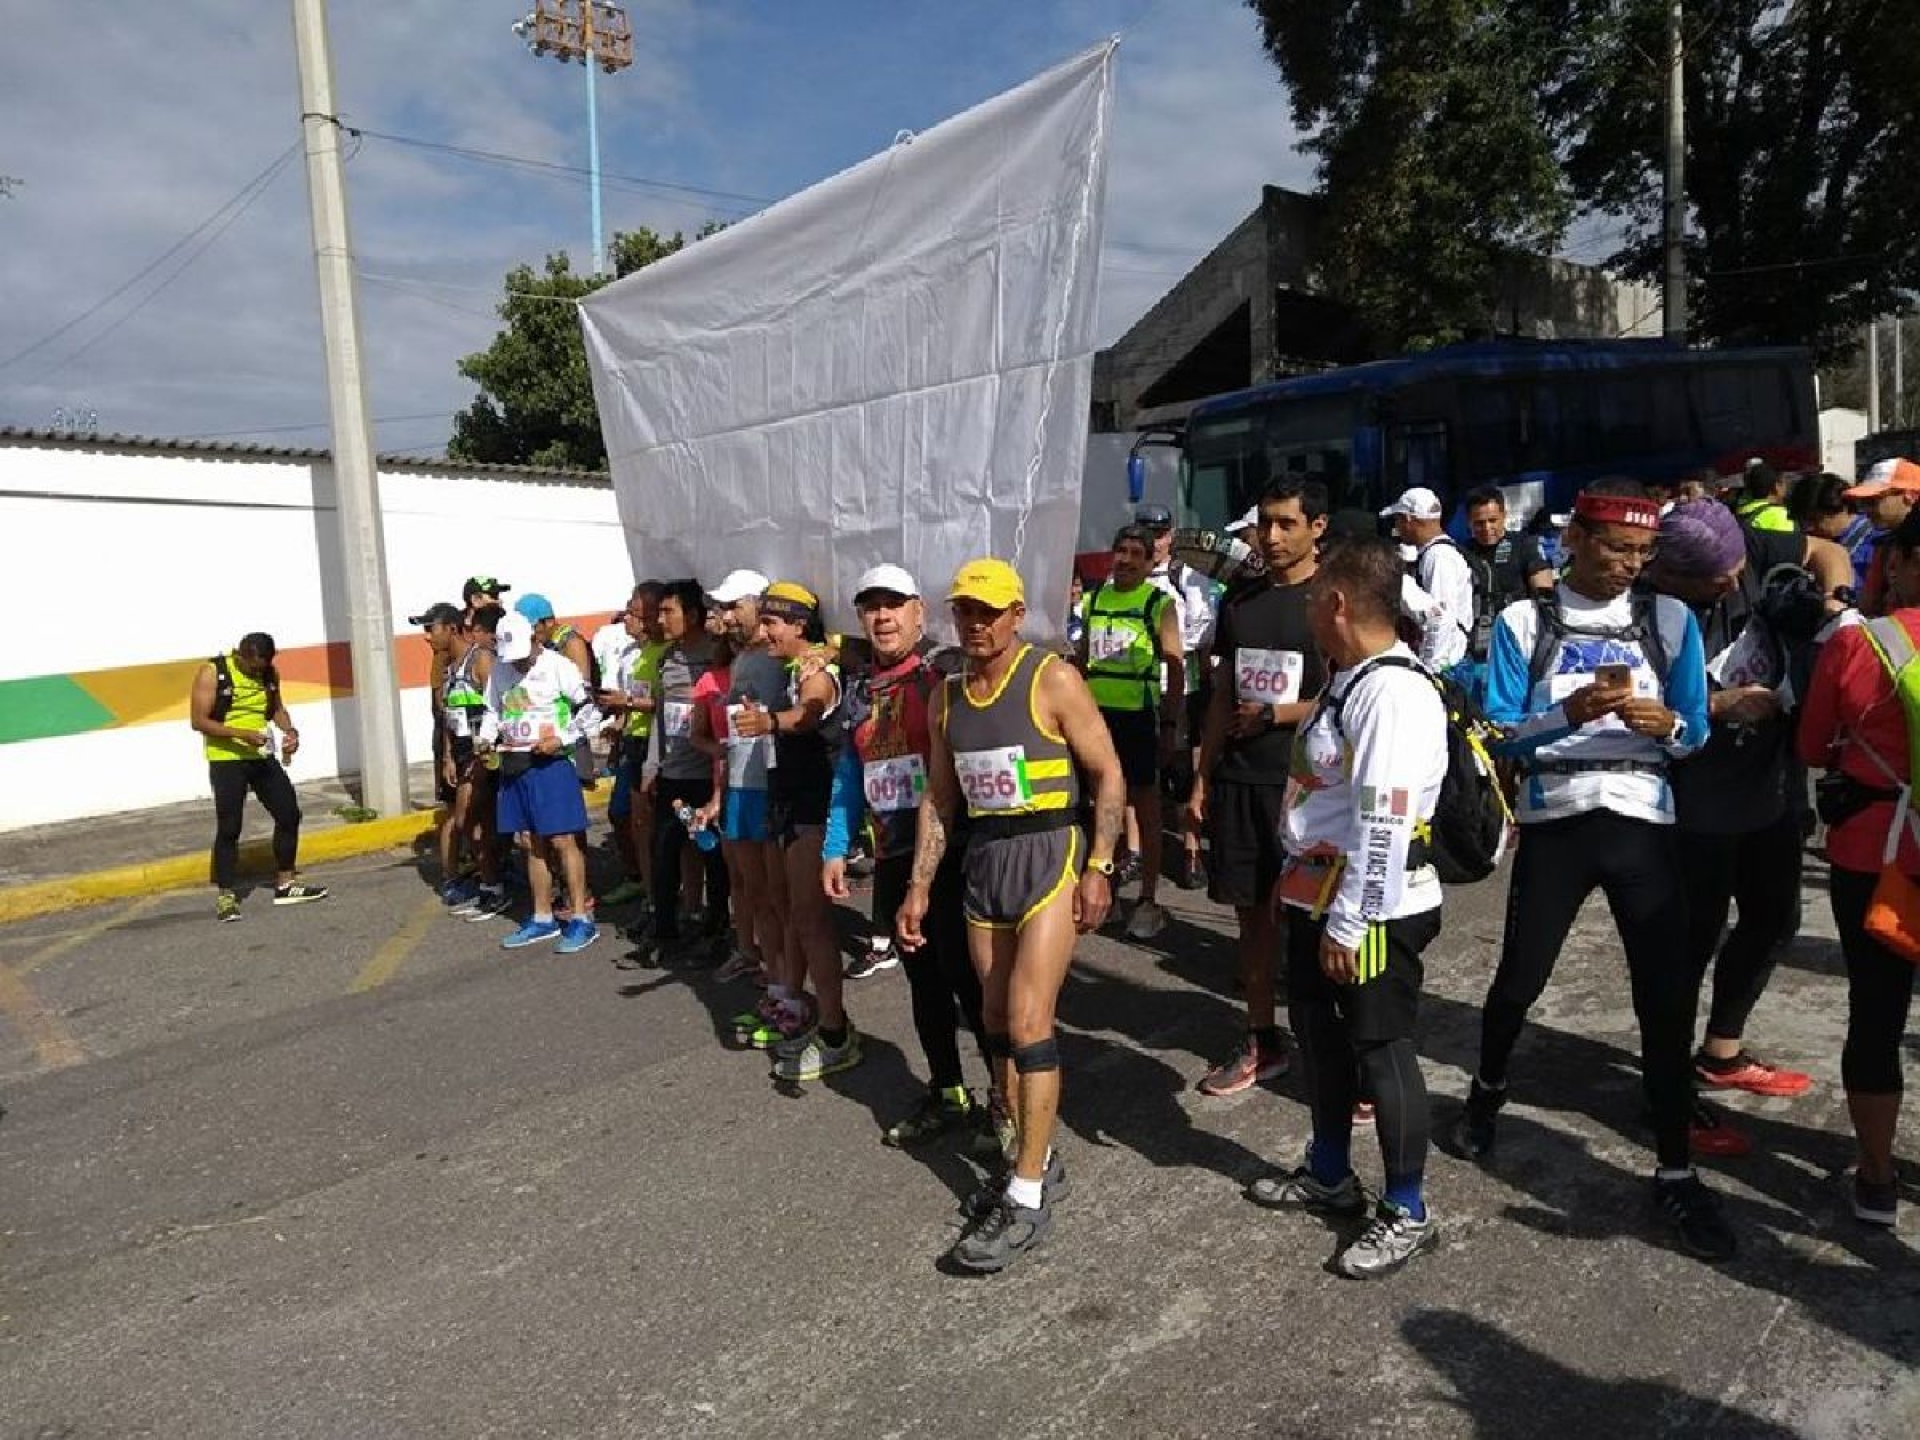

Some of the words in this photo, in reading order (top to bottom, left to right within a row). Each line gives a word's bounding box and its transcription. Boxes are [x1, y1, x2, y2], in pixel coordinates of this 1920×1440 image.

[1240, 666, 1289, 694] 260
[868, 773, 914, 802] 001
[962, 770, 1017, 799] 256
[1365, 850, 1388, 878] RACE
